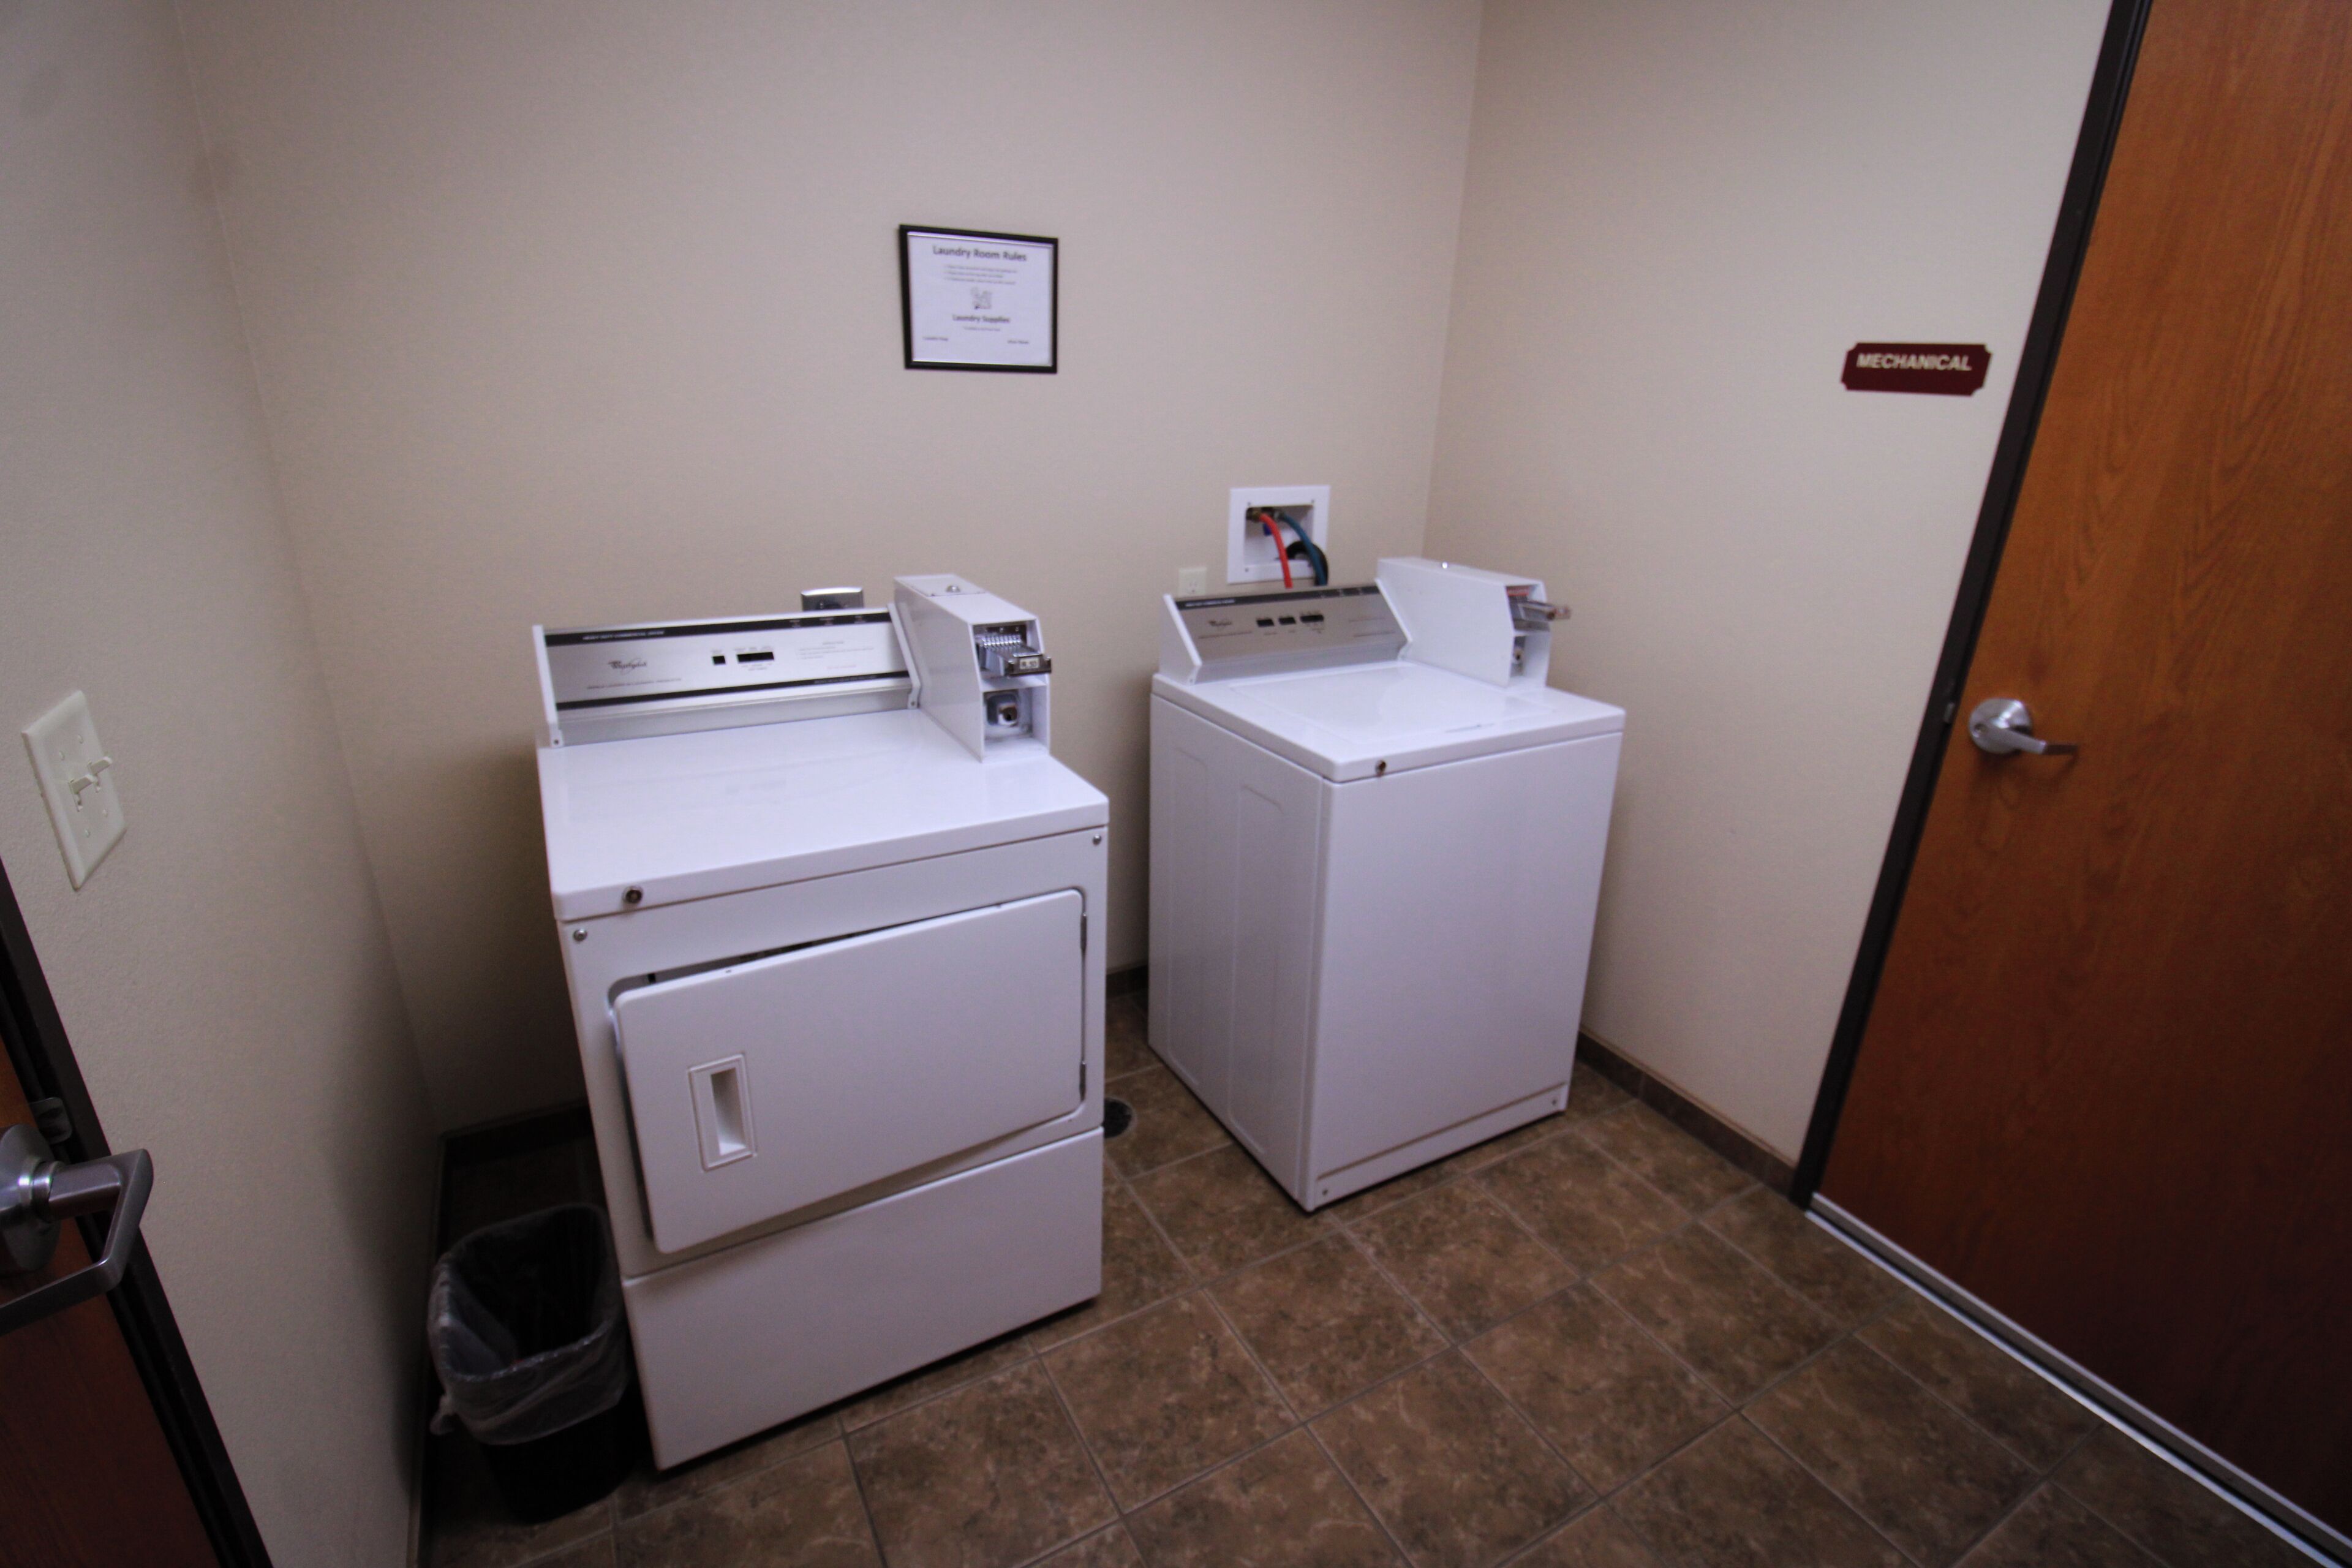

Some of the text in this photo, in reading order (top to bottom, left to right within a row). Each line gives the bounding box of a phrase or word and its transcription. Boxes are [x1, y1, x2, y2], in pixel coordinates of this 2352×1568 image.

[933, 246, 1027, 261] Laundry Room Rules
[1856, 353, 1972, 371] MECHANICAL
